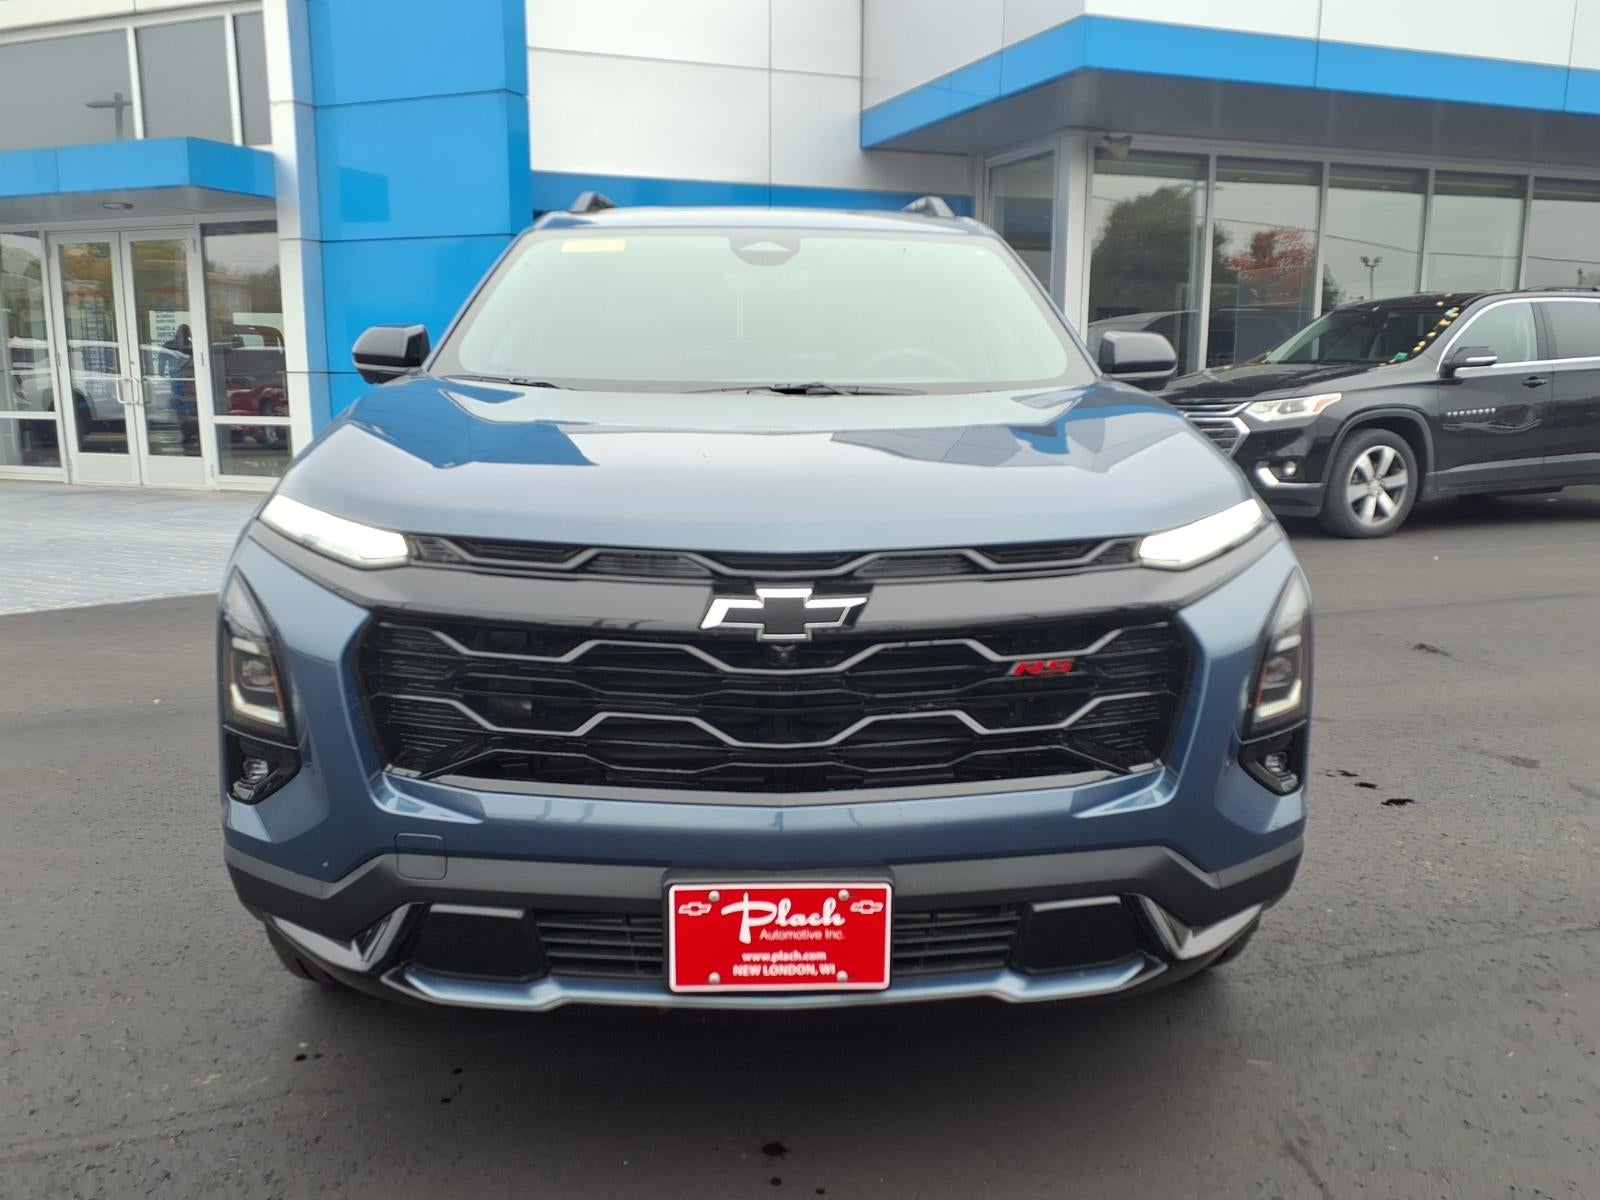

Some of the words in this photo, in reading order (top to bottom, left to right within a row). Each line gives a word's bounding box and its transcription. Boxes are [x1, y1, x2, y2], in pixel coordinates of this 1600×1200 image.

[1007, 657, 1074, 676] RS
[759, 928, 822, 941] Automotive
[825, 928, 846, 941] Inc.
[732, 964, 761, 976] NEW
[762, 964, 818, 976] LONDON,
[818, 963, 836, 975] WI
